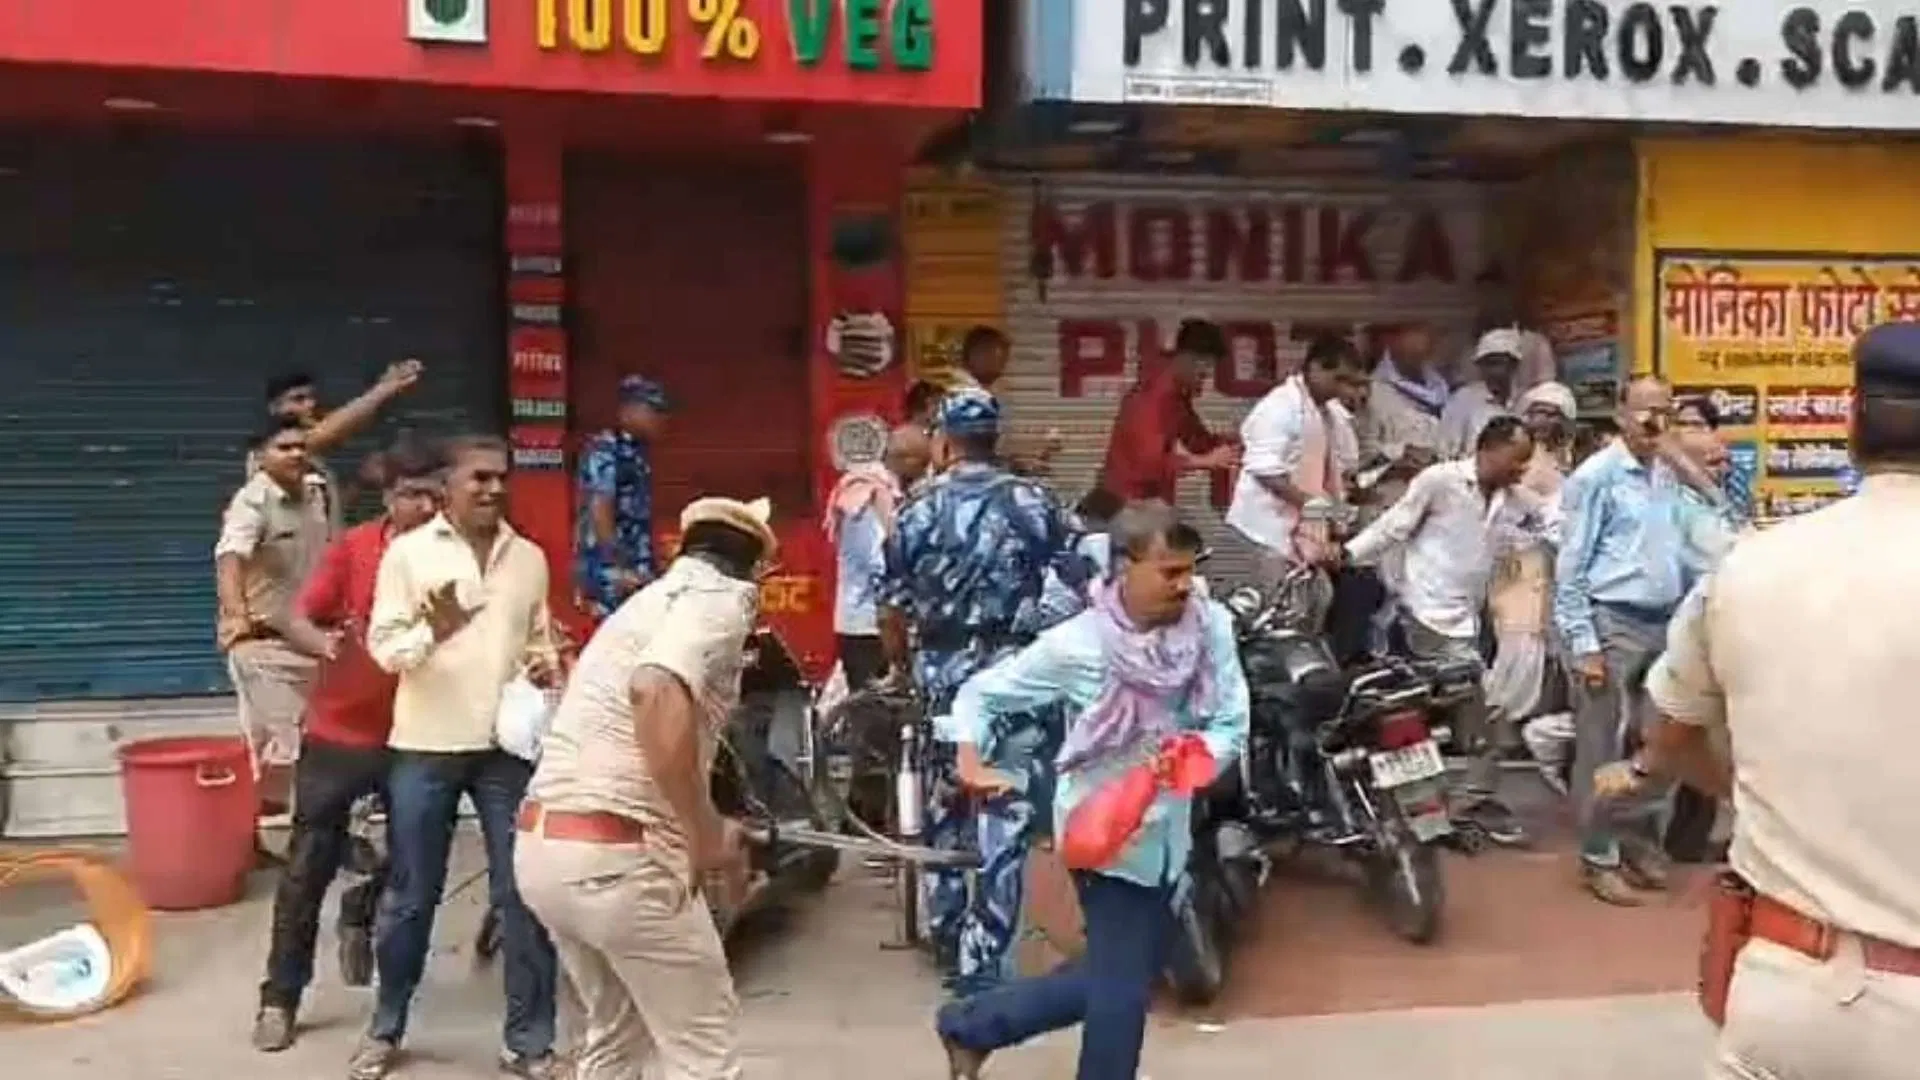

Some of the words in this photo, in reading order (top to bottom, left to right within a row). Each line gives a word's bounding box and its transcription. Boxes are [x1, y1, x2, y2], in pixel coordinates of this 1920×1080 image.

[786, 0, 934, 70] VEG
[1034, 202, 1457, 283] MONIKA
[1666, 262, 1790, 336] मोनिका
[1799, 265, 1878, 337] फोटो
